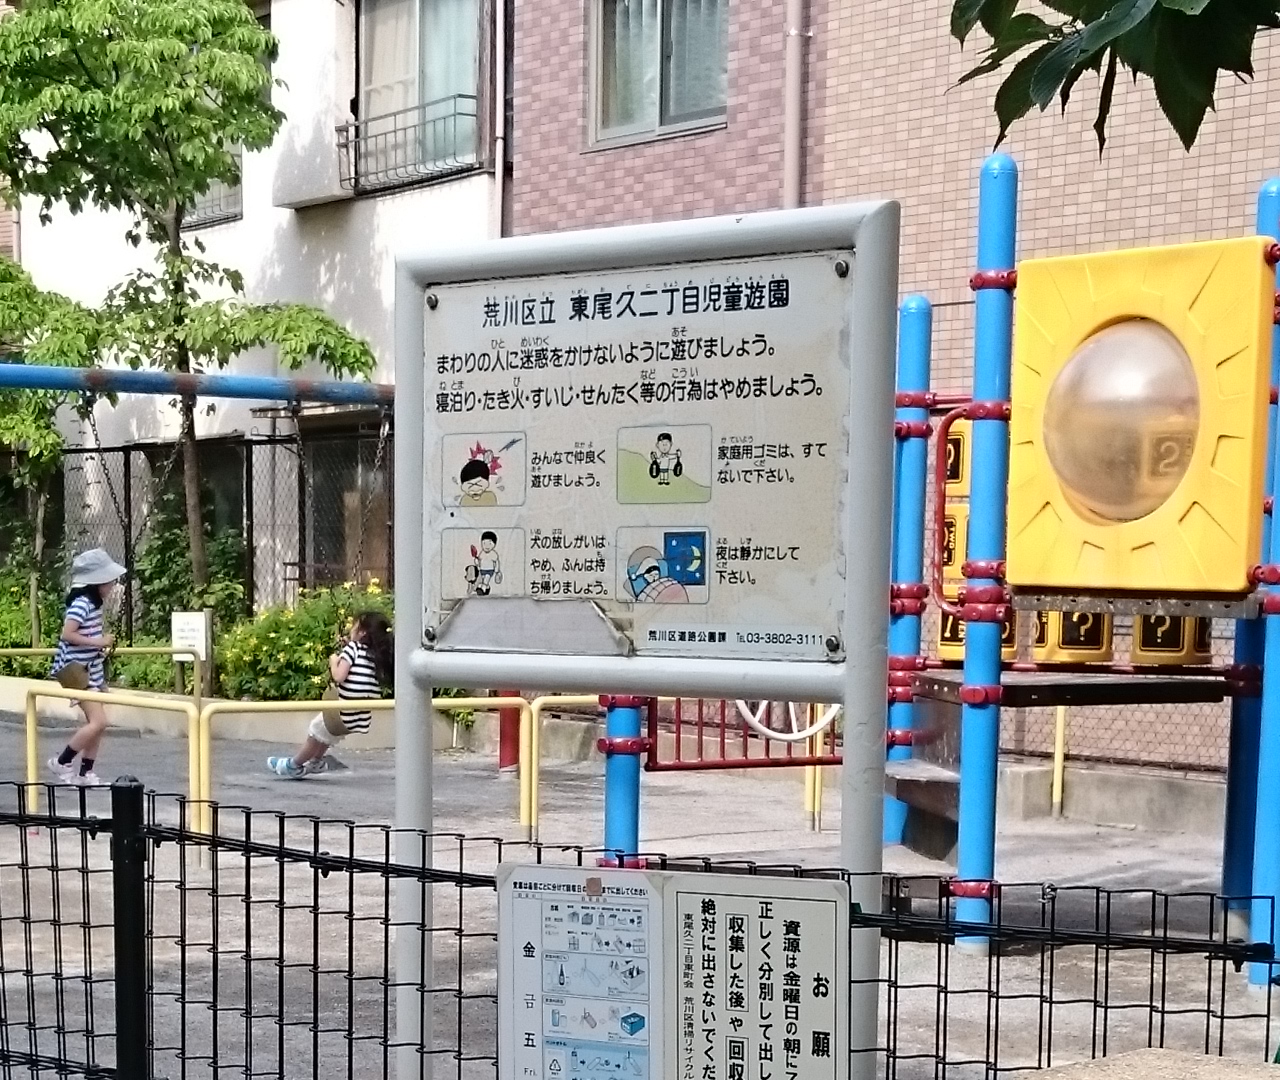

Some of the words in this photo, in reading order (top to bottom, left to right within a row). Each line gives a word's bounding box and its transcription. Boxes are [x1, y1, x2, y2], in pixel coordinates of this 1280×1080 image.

[482, 297, 556, 328] 荒川区立
[569, 279, 790, 321] 東尾久二丁目児童遊園
[437, 333, 775, 375] まわりの人に迷惑をかけないように遊びましょう。
[531, 449, 606, 465] みんなで仲良く
[531, 473, 600, 488] 遊びましょう。
[717, 468, 795, 484] ないで下さい。
[716, 546, 800, 561] 夜は静かにして
[715, 569, 756, 585] 下さい。
[530, 580, 609, 595] ち帰りましょう。
[523, 941, 536, 958] 金
[683, 913, 695, 989] 東尾久二丁目東町会
[524, 993, 536, 1009] 금
[524, 1032, 536, 1048] 五
[524, 1068, 538, 1077] Fri.
